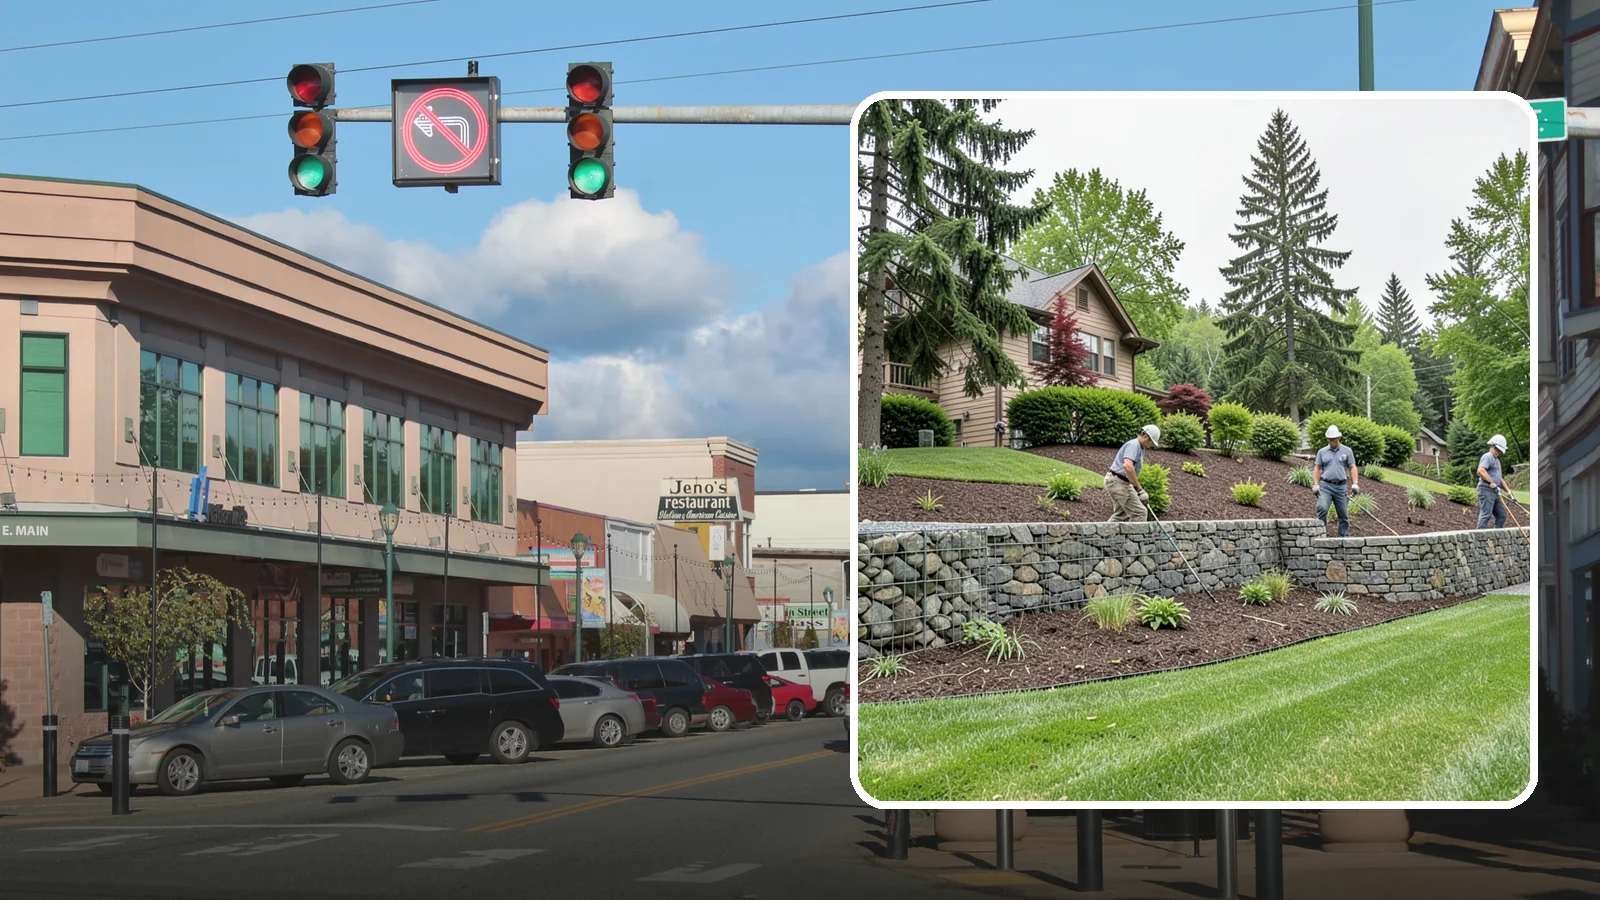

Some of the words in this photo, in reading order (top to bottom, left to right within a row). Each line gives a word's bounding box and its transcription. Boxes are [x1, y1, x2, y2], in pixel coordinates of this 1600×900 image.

[670, 480, 727, 494] Jeno's
[665, 497, 731, 509] restaurant
[659, 510, 681, 519] Italian
[686, 510, 714, 519] American
[715, 509, 737, 519] Cuisine
[2, 525, 13, 536] E.
[15, 525, 49, 536] MAIN
[797, 607, 829, 617] Street
